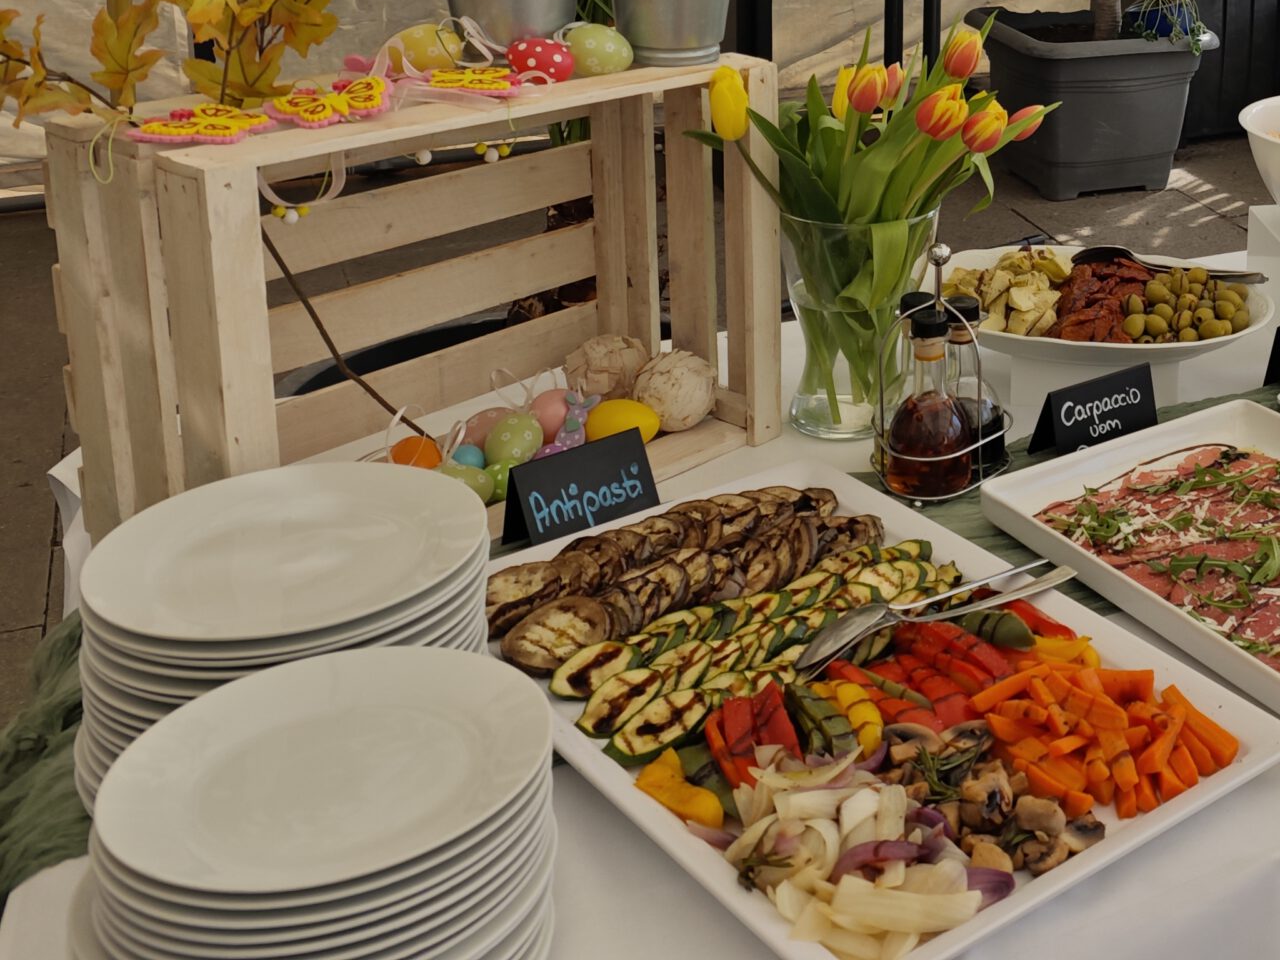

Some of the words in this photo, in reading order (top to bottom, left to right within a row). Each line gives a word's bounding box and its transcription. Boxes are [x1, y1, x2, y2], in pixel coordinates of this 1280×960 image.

[1060, 386, 1141, 427] Carpaccio
[1089, 418, 1122, 438] vom
[528, 462, 643, 534] Antipasti
